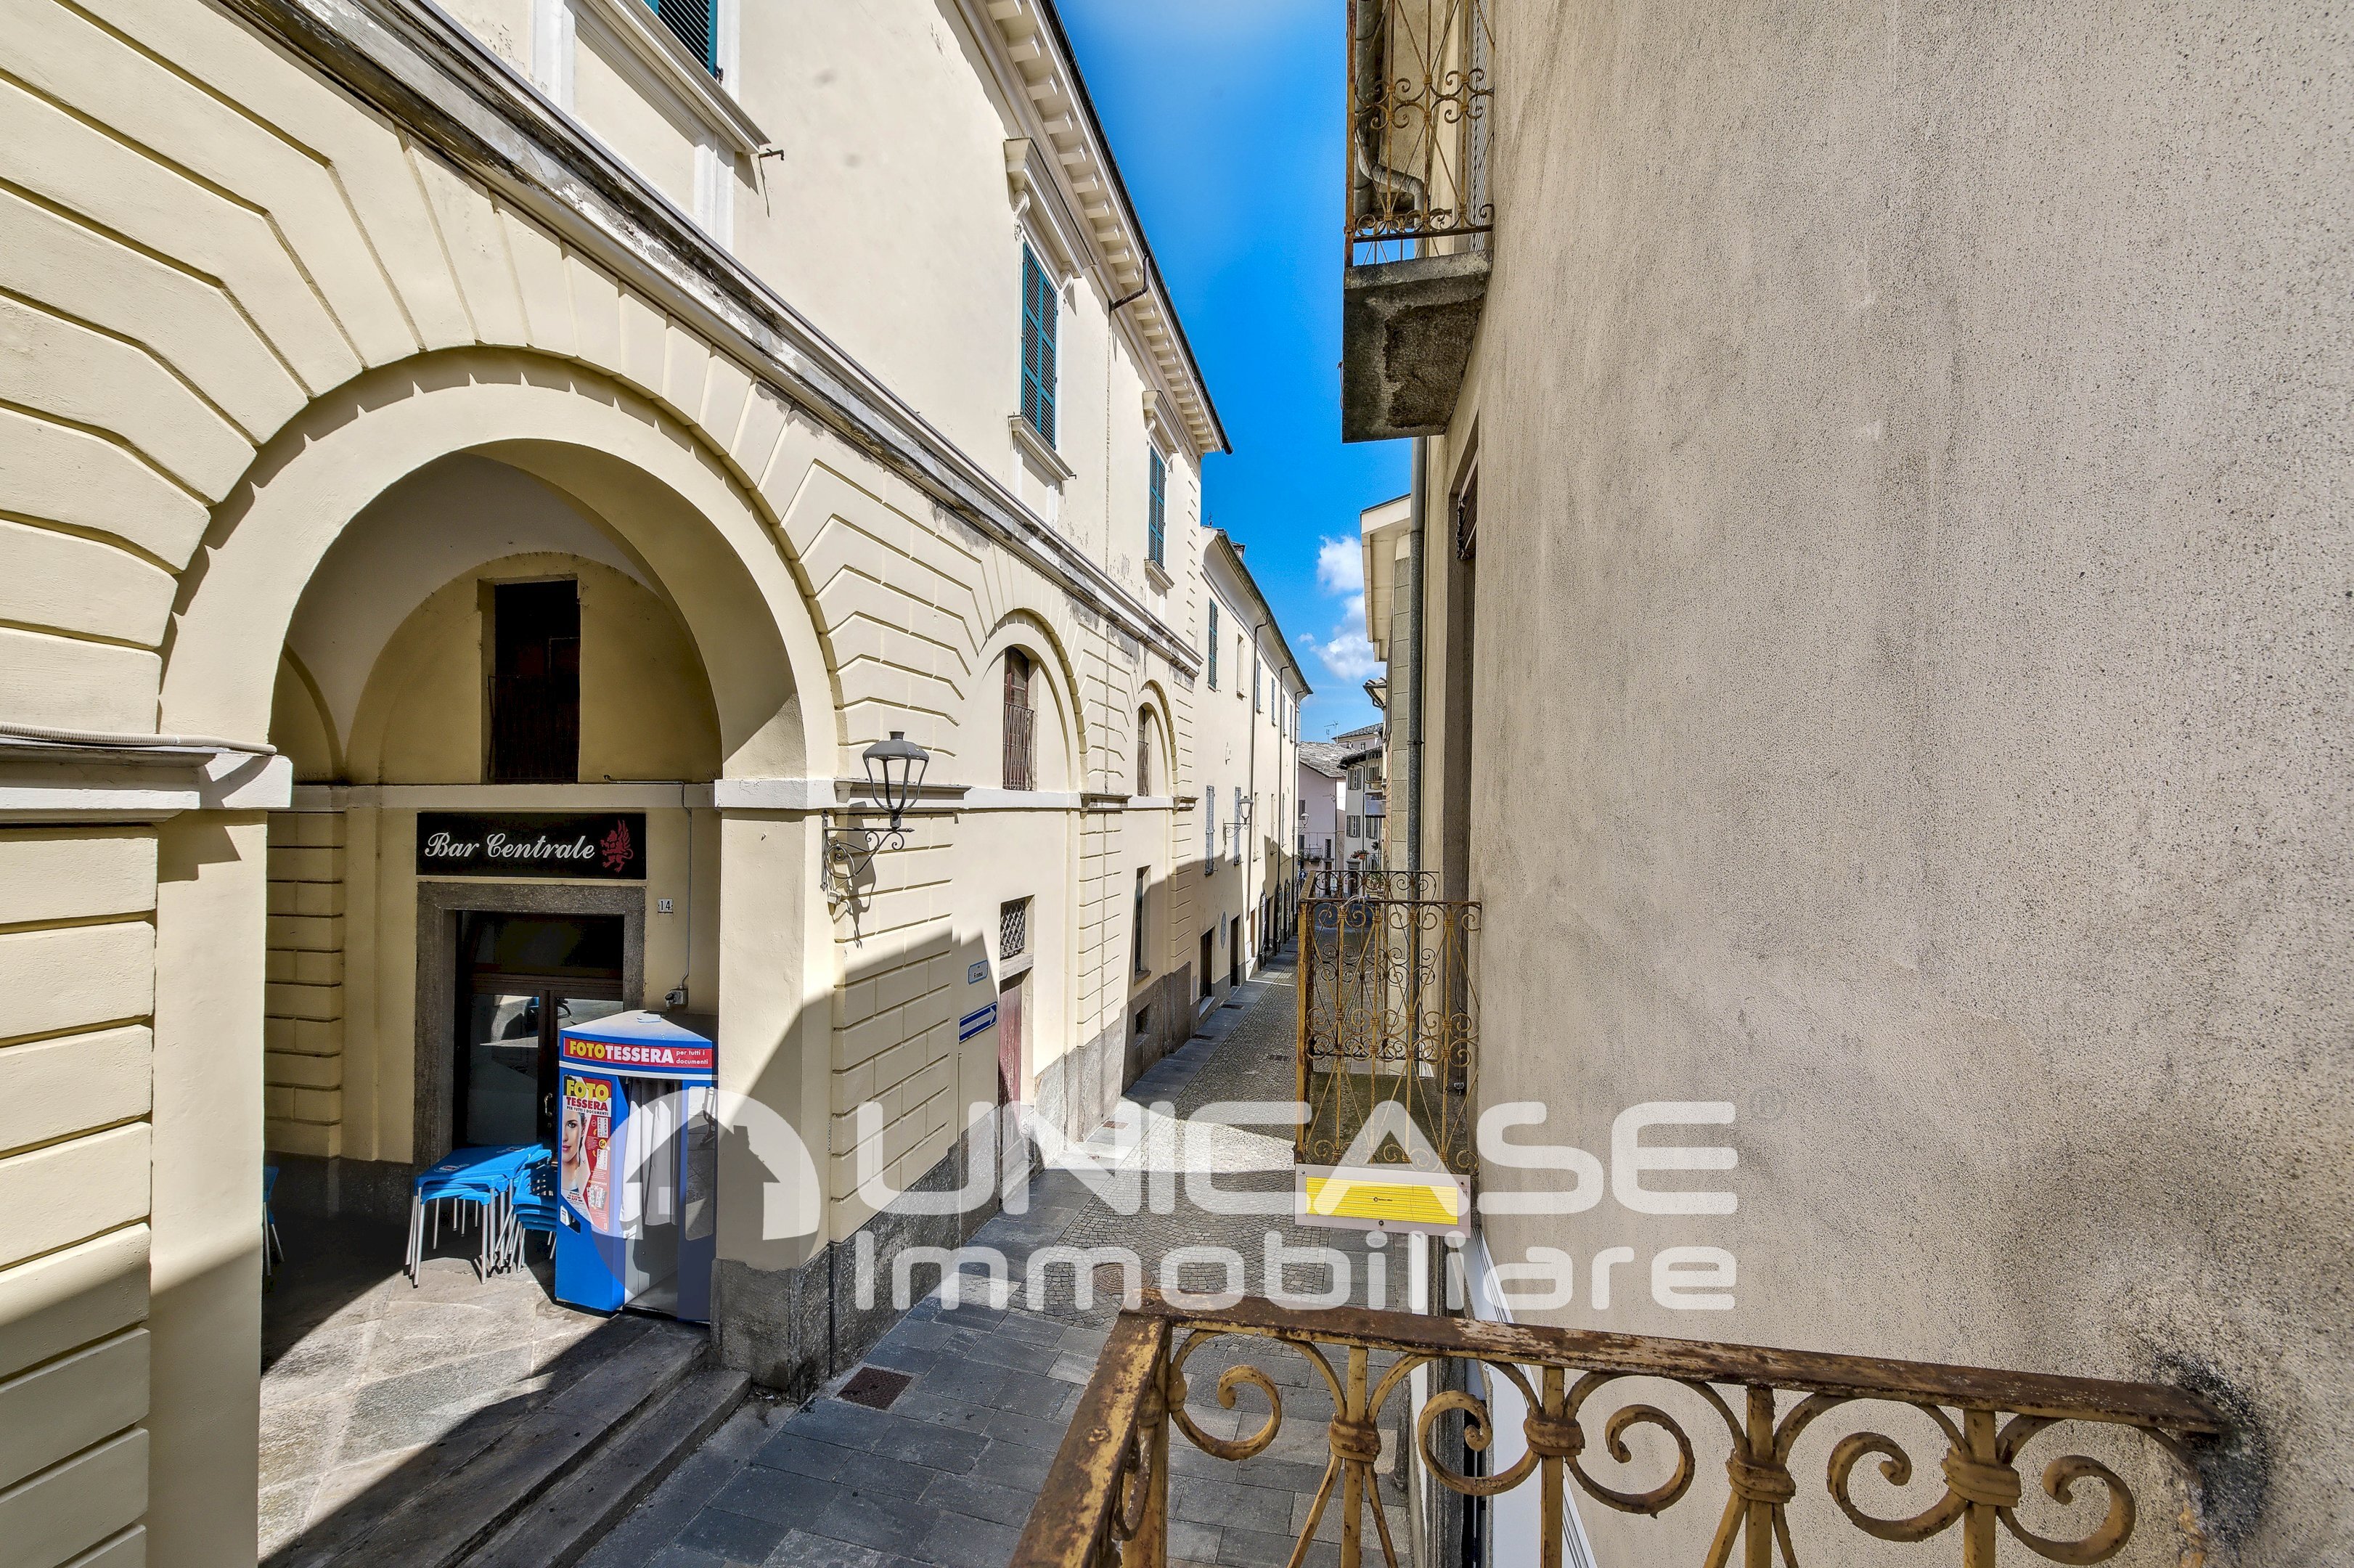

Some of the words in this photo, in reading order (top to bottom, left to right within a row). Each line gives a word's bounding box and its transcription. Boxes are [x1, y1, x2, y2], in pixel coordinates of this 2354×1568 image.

[424, 832, 480, 857] Bar
[486, 833, 596, 859] Centrale
[661, 900, 671, 910] 14
[570, 1040, 674, 1063] FOTOTESSERA
[566, 1079, 609, 1102] FOTO
[566, 1097, 608, 1111] TESSERA
